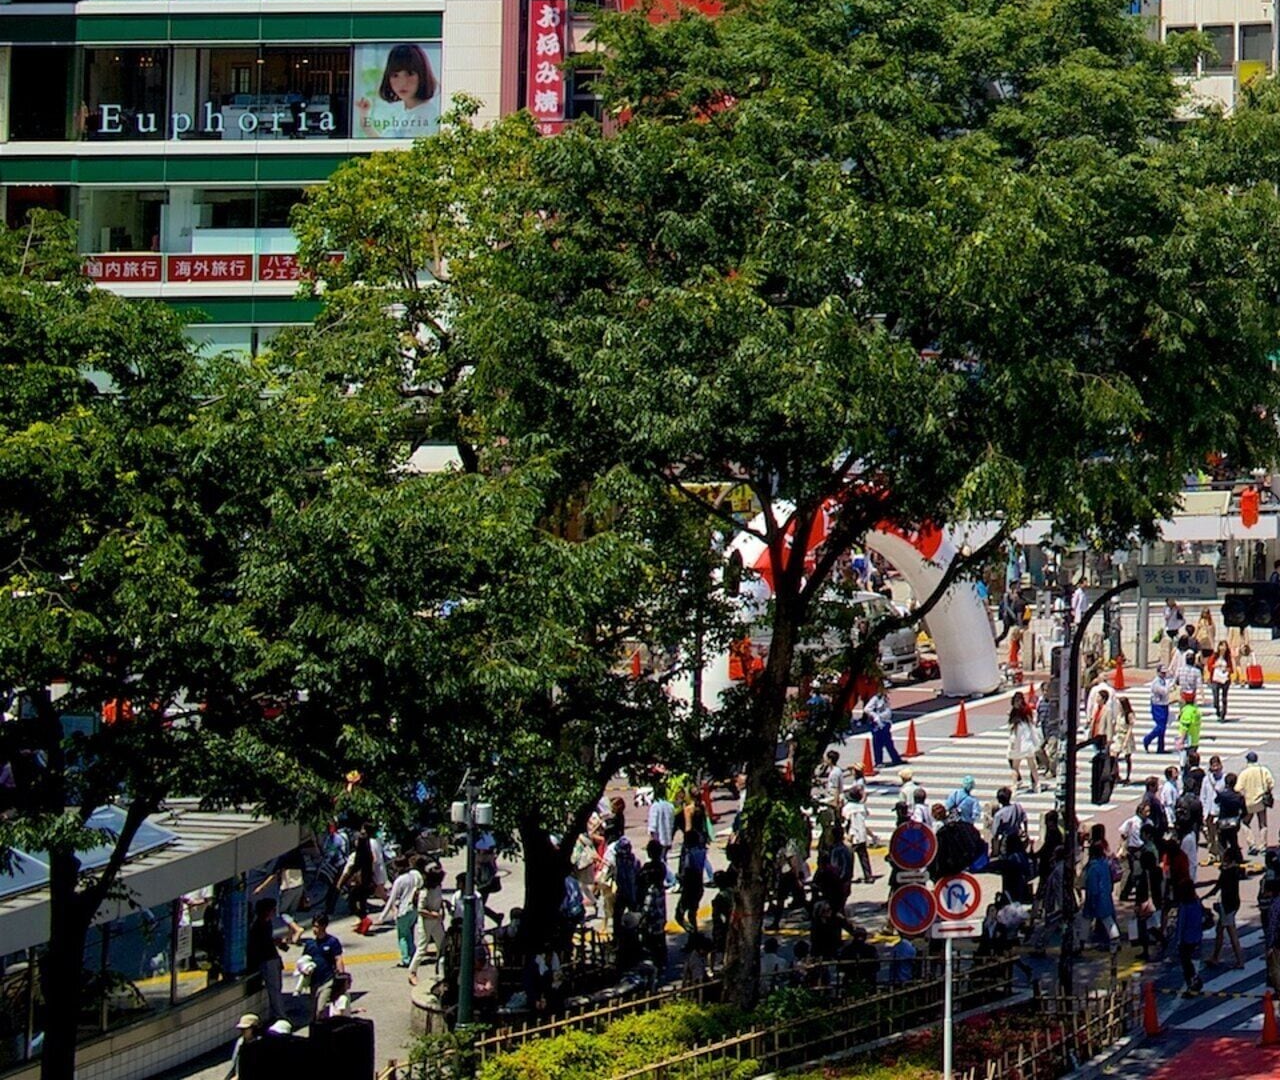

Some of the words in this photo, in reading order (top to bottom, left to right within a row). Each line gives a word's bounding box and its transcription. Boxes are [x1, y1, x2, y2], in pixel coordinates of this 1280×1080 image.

[535, 4, 560, 113] お好み焼
[98, 103, 336, 140] Euphoria
[362, 116, 430, 130] Euphoria
[175, 260, 246, 277] 海外旅行
[1144, 569, 1210, 584] 渋谷駅前
